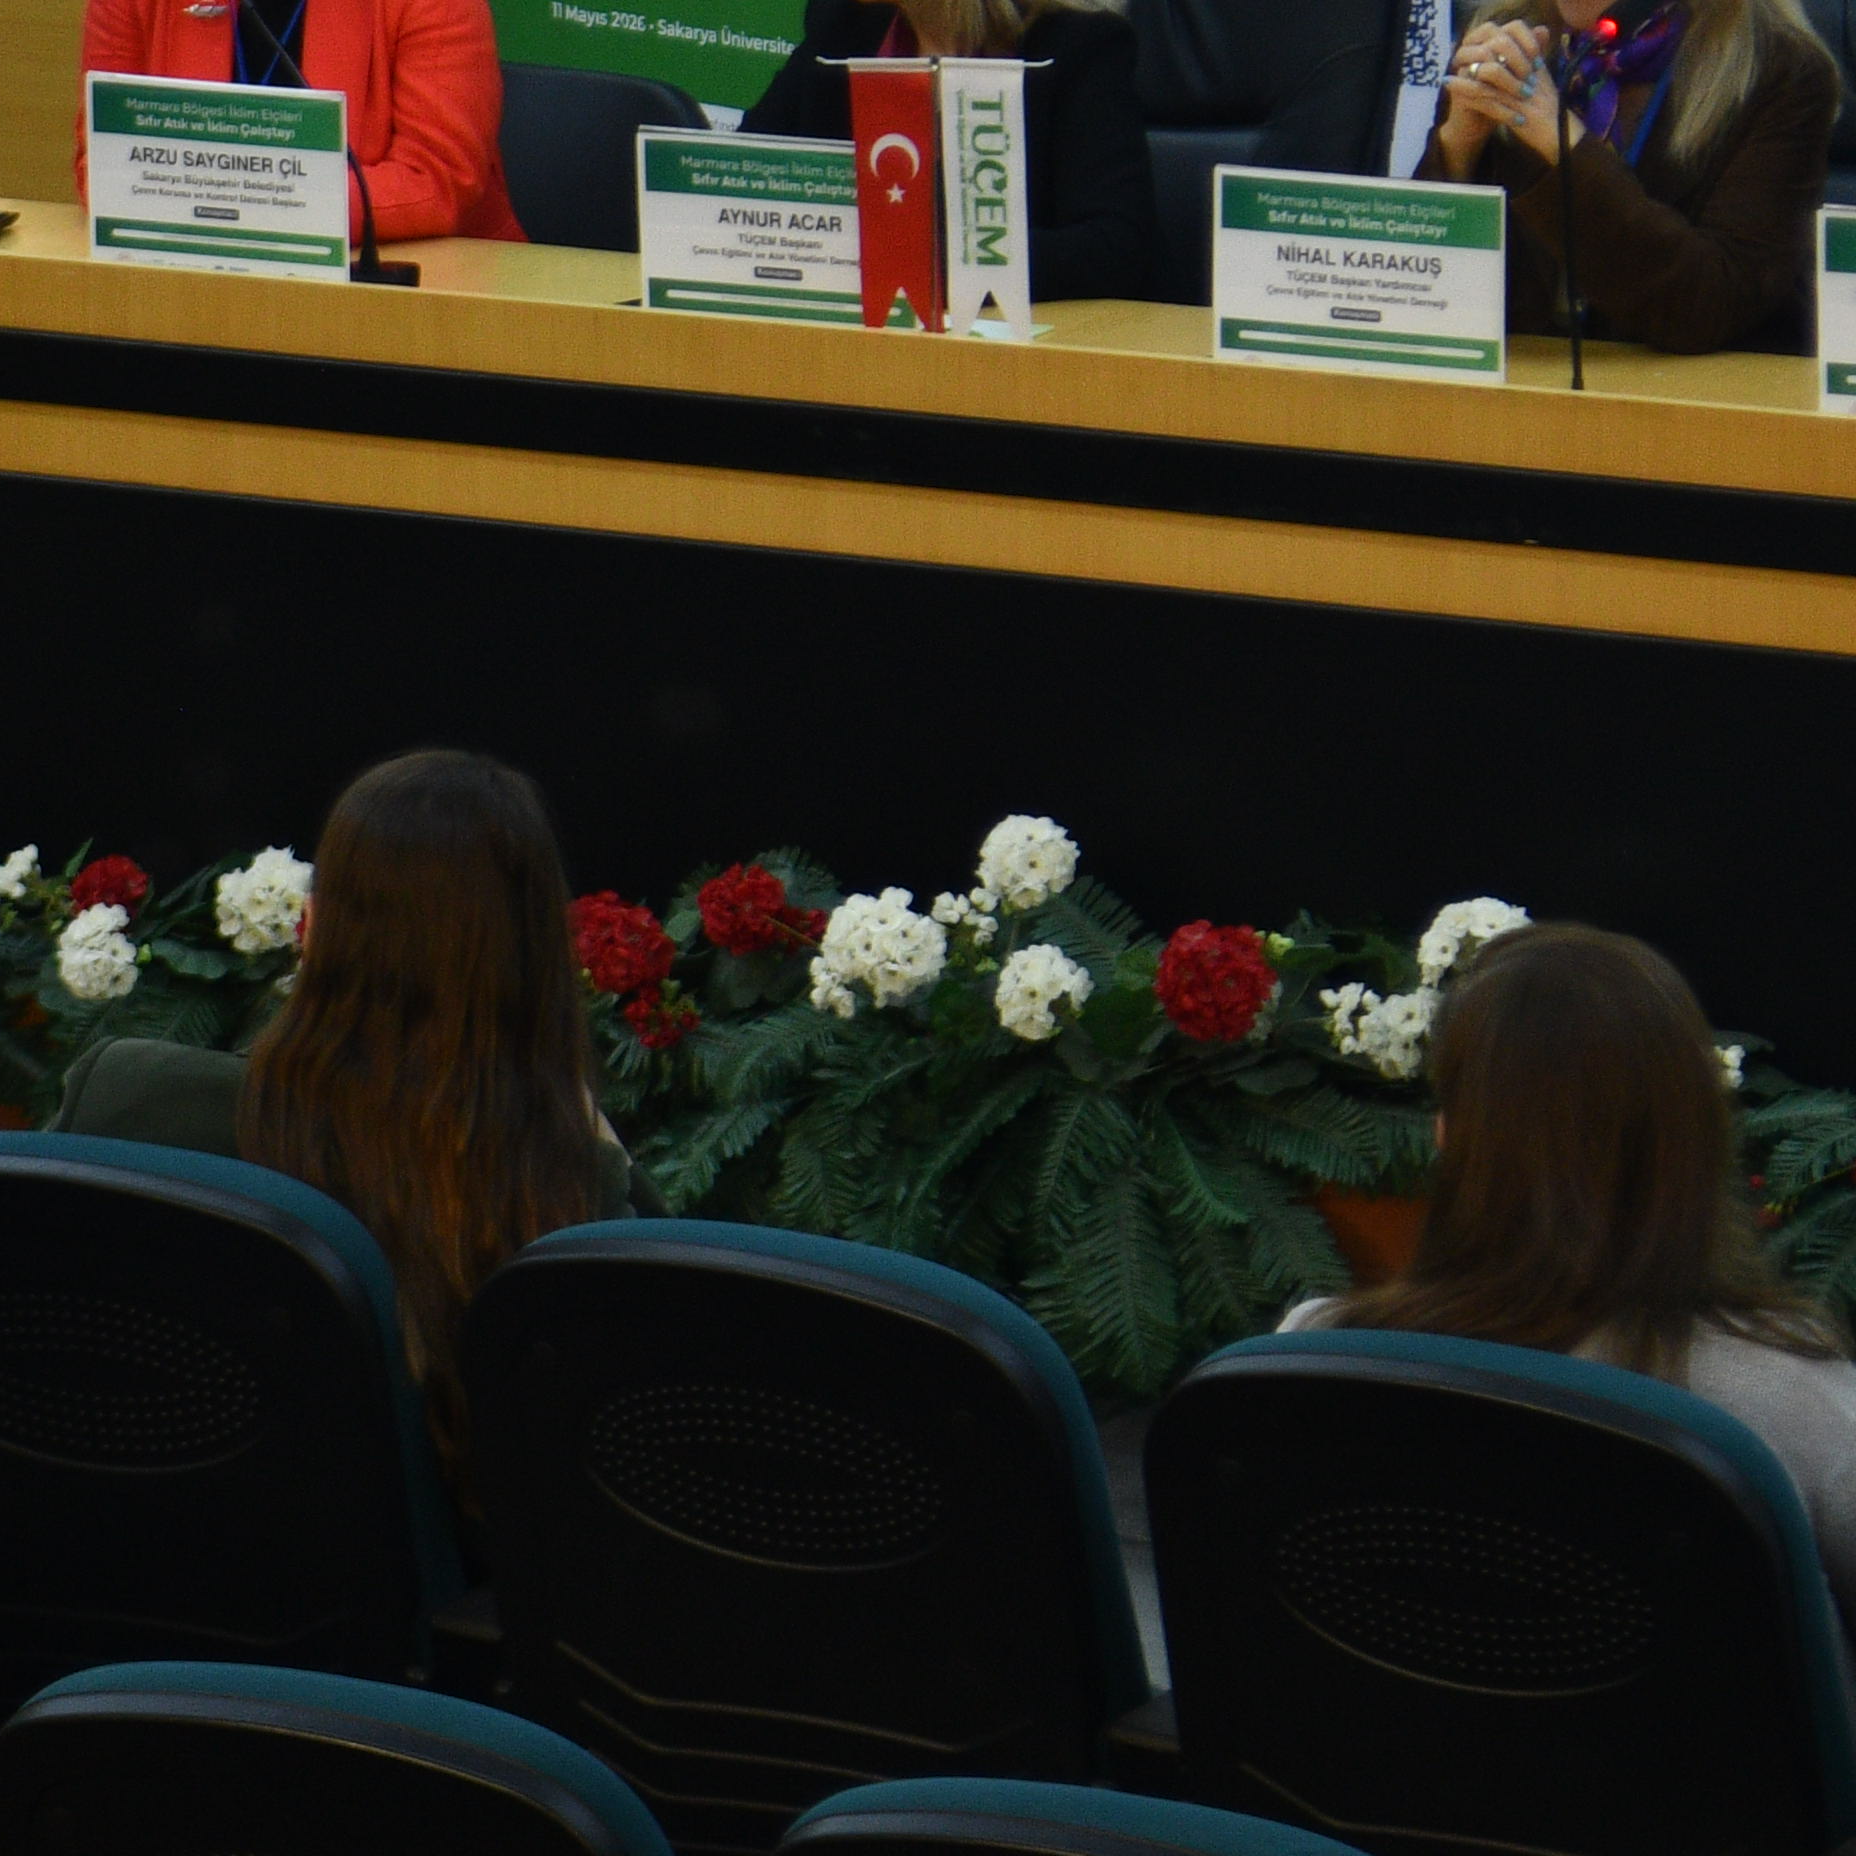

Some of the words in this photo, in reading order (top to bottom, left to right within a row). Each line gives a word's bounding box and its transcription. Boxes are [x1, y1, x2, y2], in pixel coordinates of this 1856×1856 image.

[565, 5, 608, 27] Mayıs
[611, 11, 647, 32] 2026
[658, 18, 717, 45] Sakarya
[720, 25, 796, 55] Üniversite
[129, 146, 177, 165] ARZU
[183, 150, 273, 174] SAYGINER
[279, 155, 307, 180] ÇİL
[971, 90, 1010, 265] TÜÇEM
[803, 182, 857, 199] Çalıştay
[718, 208, 782, 228] AYNUR
[788, 213, 842, 233] ACAR
[1276, 241, 1337, 266] NİHAL
[1343, 249, 1442, 279] KARAKUŞ
